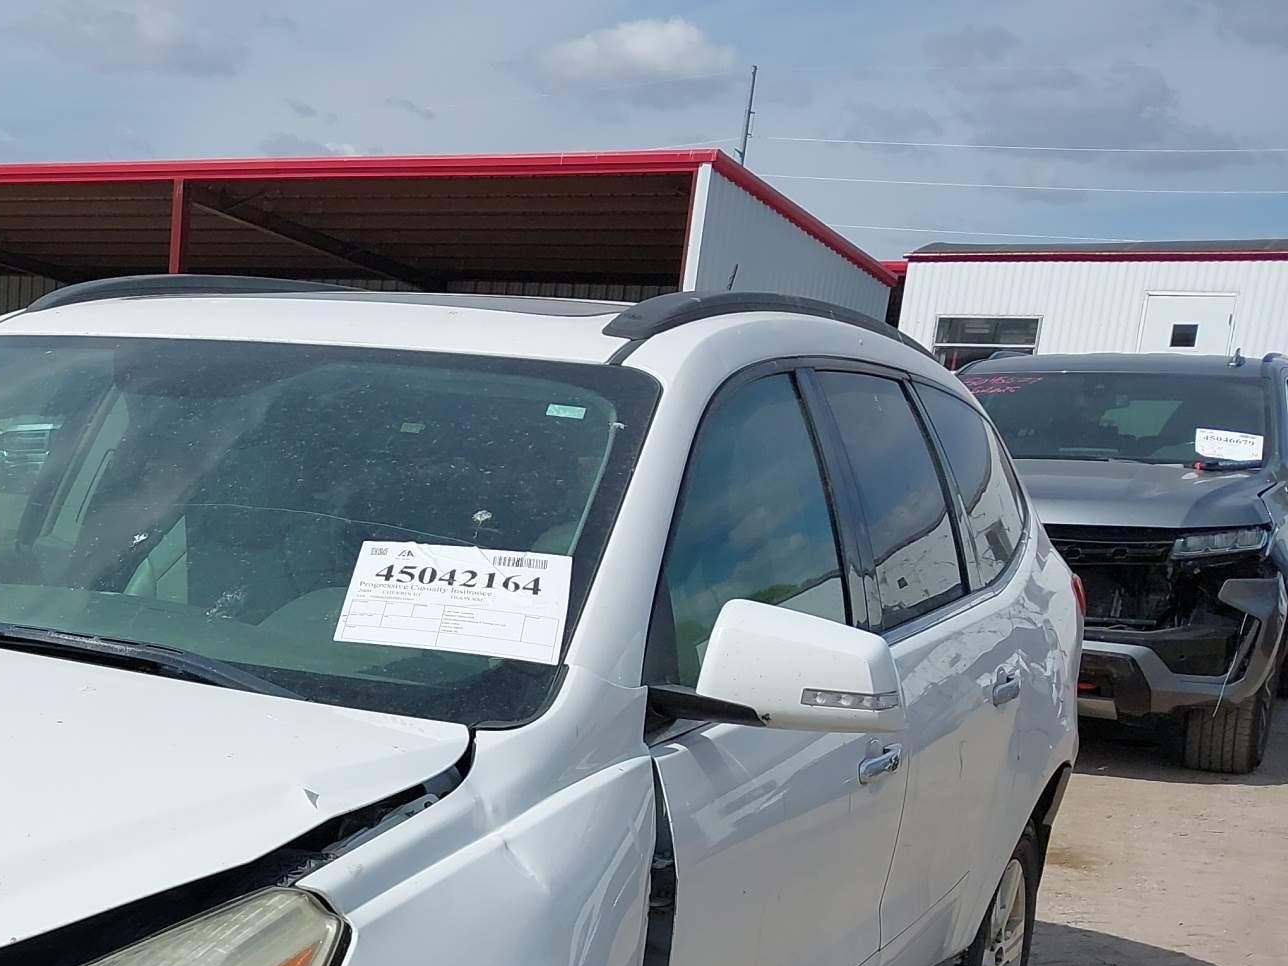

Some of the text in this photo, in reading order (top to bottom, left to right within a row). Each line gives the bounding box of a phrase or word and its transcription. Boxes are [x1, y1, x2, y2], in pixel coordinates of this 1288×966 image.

[359, 580, 410, 591] Progressive
[410, 584, 448, 594] Casualty
[375, 563, 542, 596] 45042164
